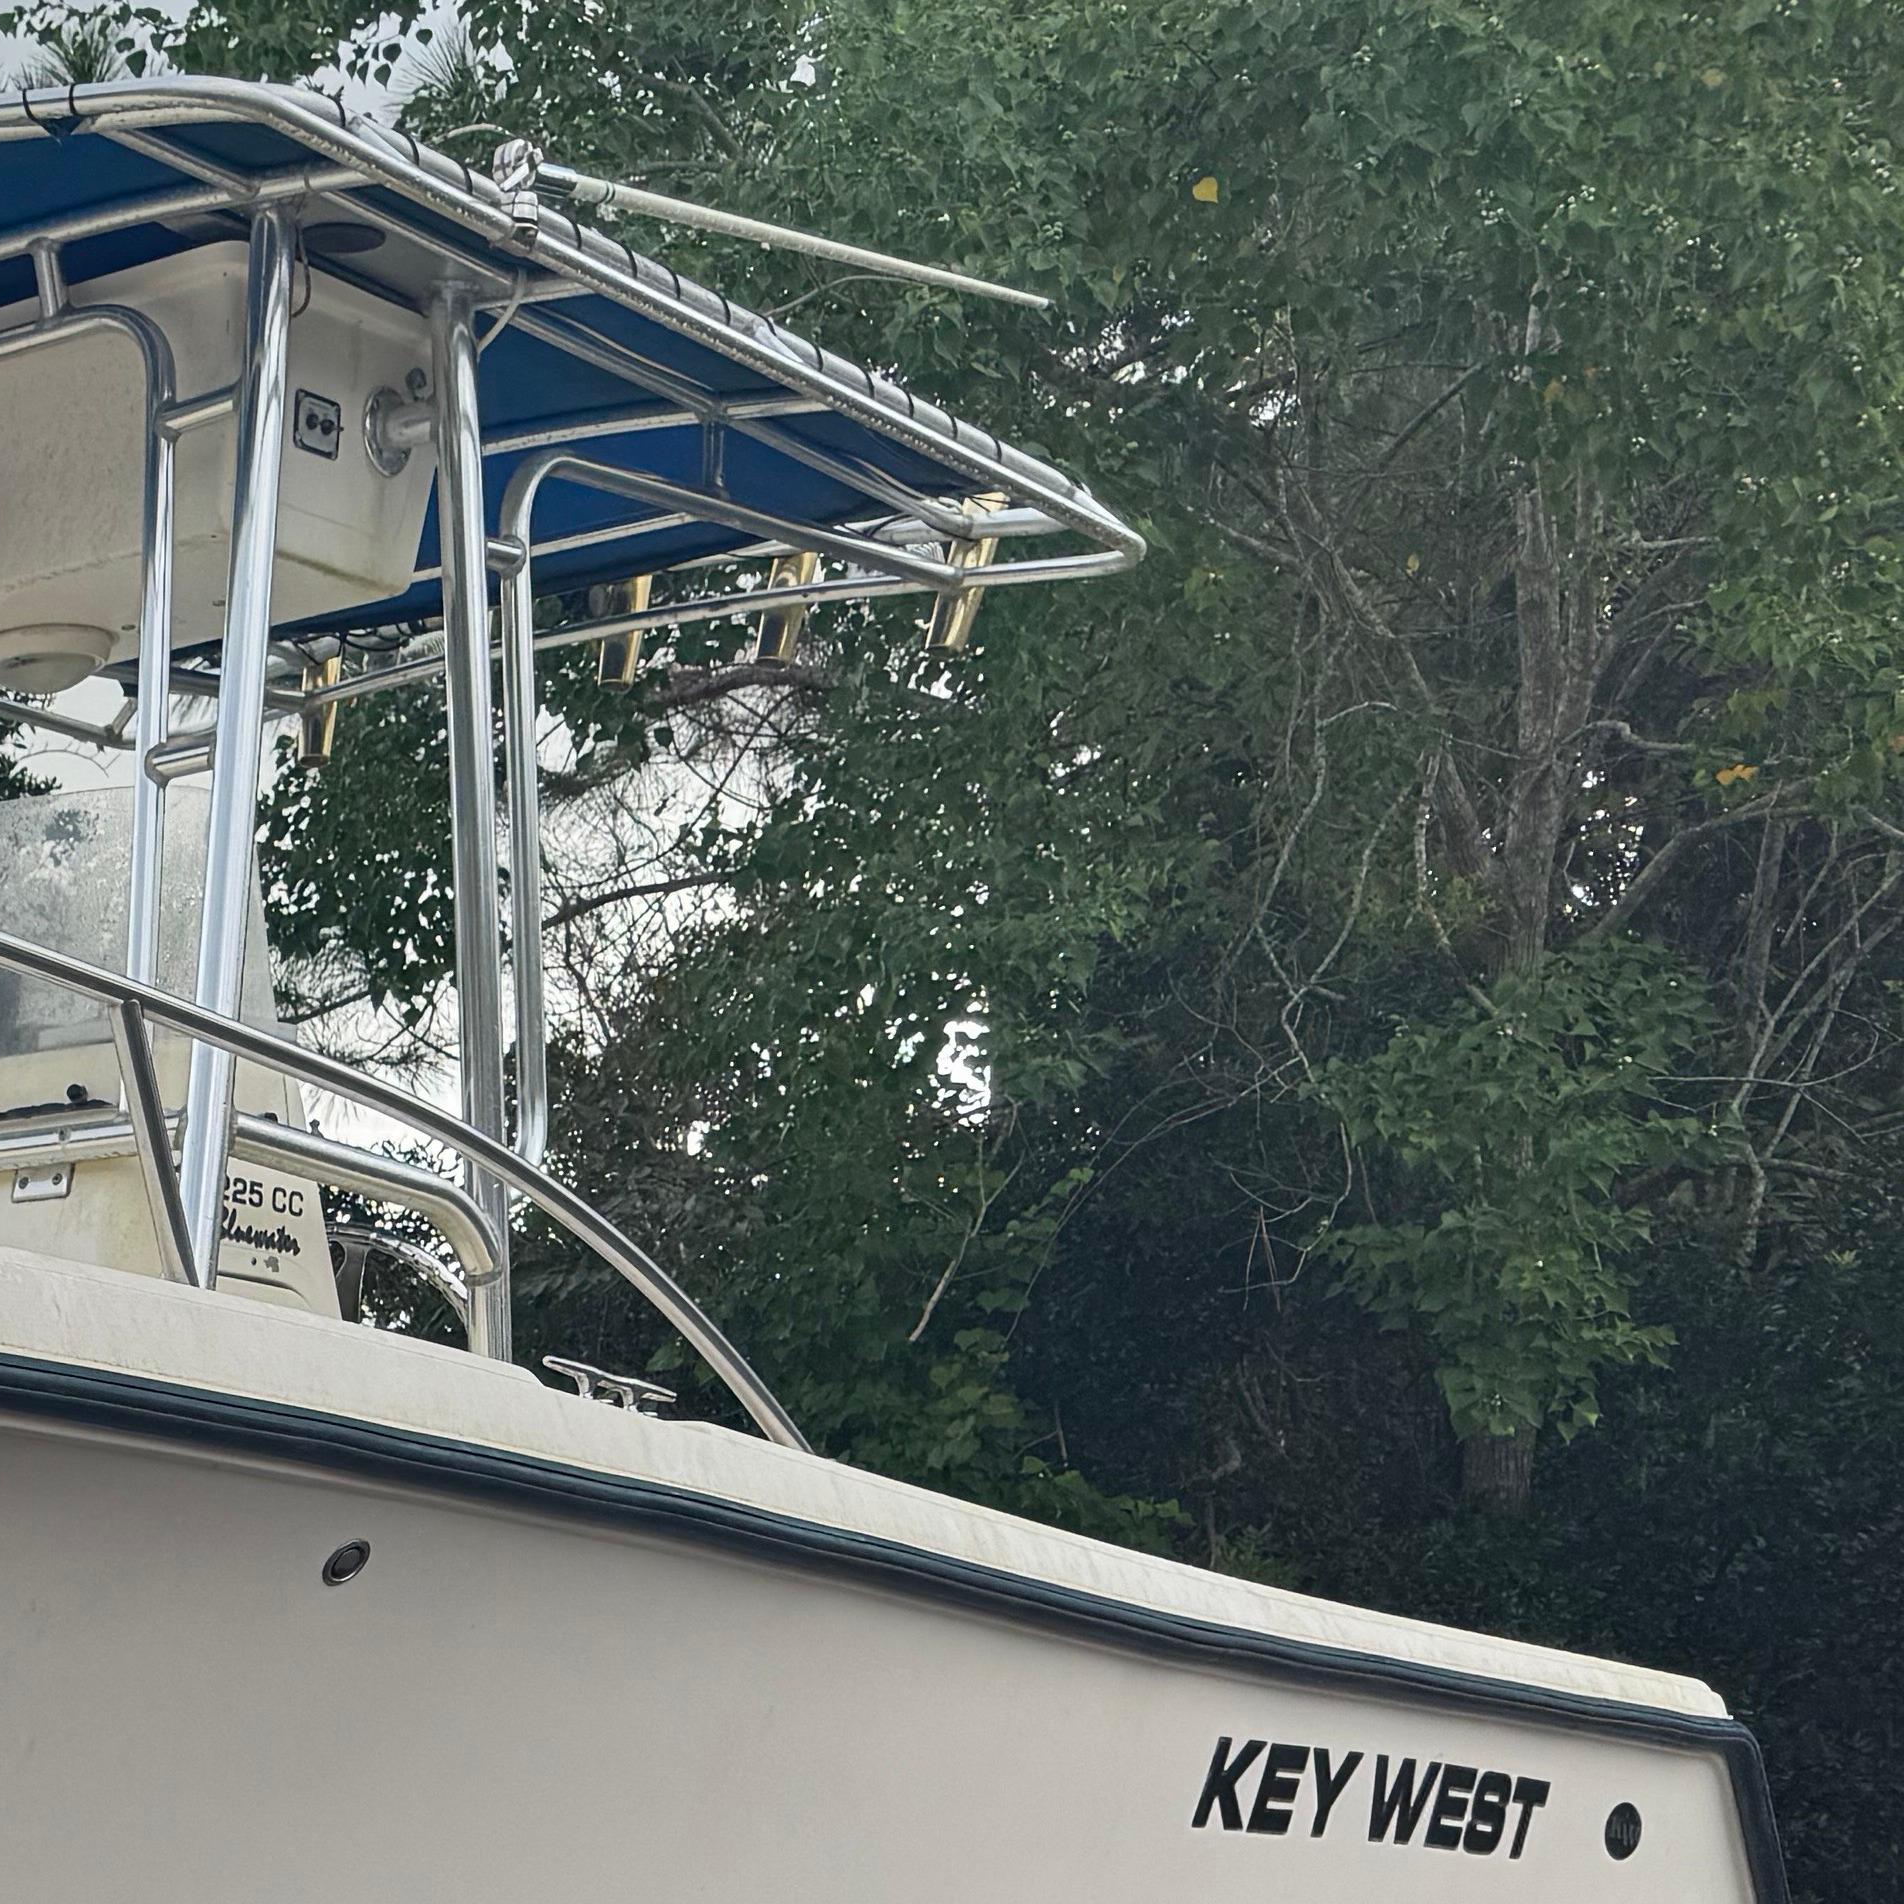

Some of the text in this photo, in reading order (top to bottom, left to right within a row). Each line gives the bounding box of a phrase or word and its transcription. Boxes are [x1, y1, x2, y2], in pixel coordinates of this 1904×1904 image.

[272, 1186, 304, 1217] CC
[1191, 1735, 1551, 1860] KEY WEST
